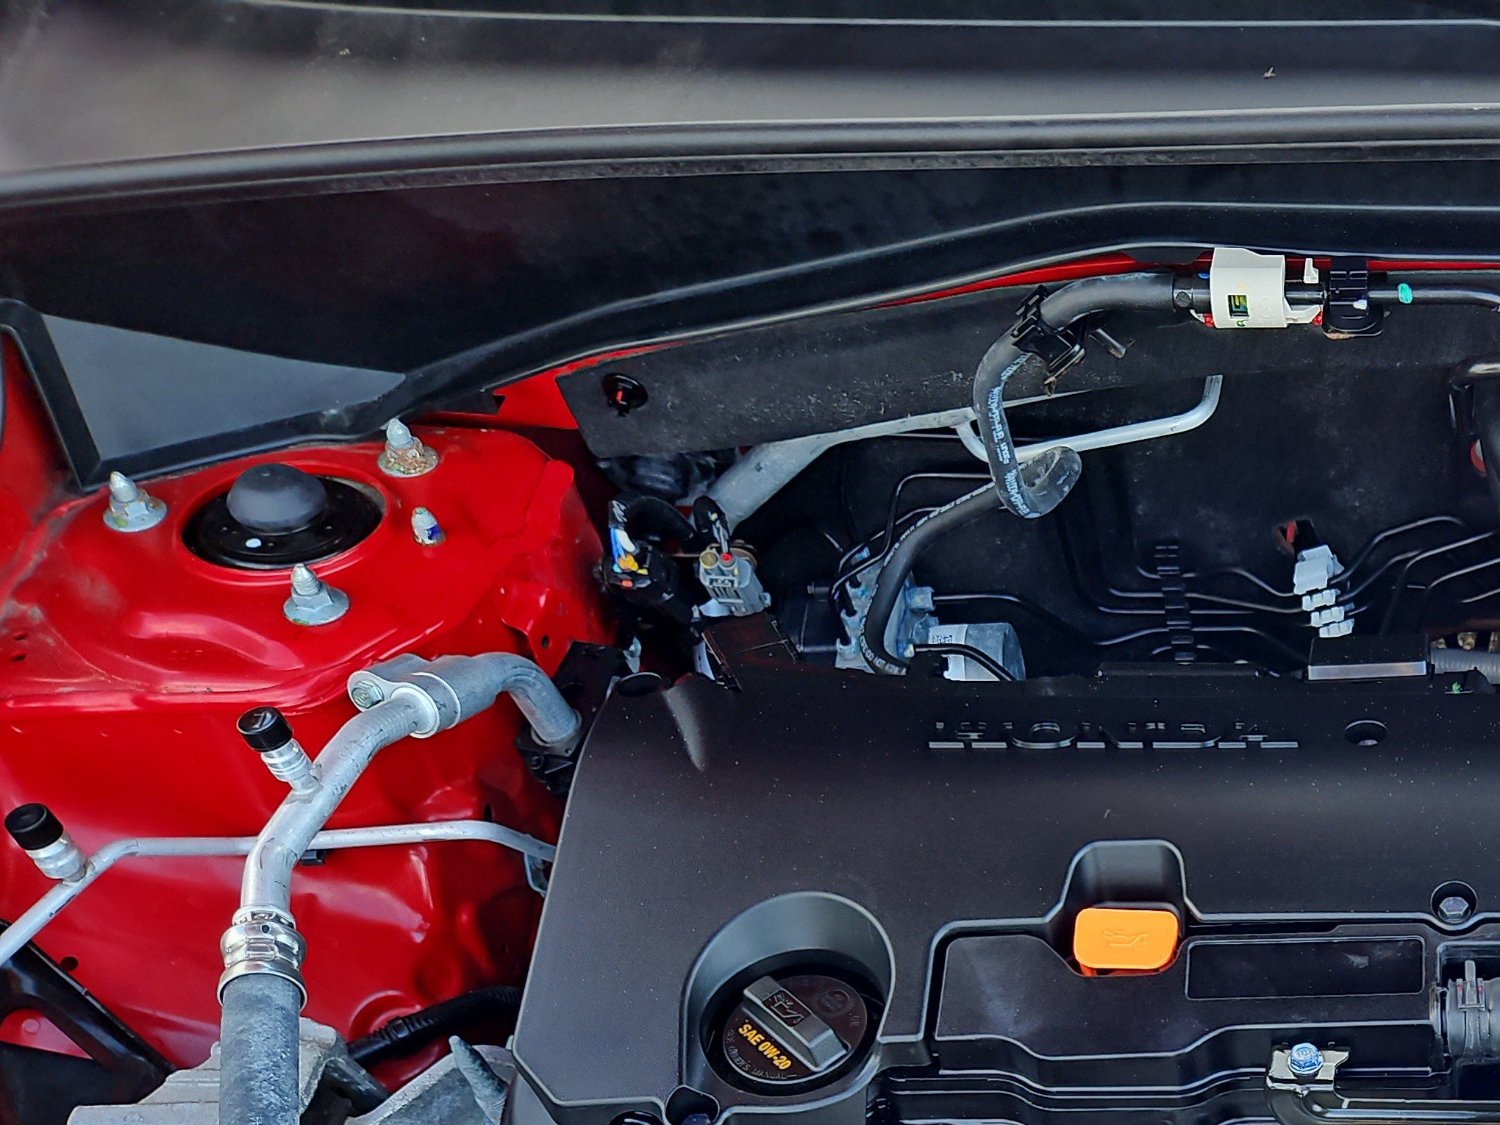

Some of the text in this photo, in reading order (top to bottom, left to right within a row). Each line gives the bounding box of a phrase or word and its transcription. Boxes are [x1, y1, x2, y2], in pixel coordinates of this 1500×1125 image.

[928, 719, 1299, 749] HONDA
[738, 1023, 792, 1070] SAE 0W-20
